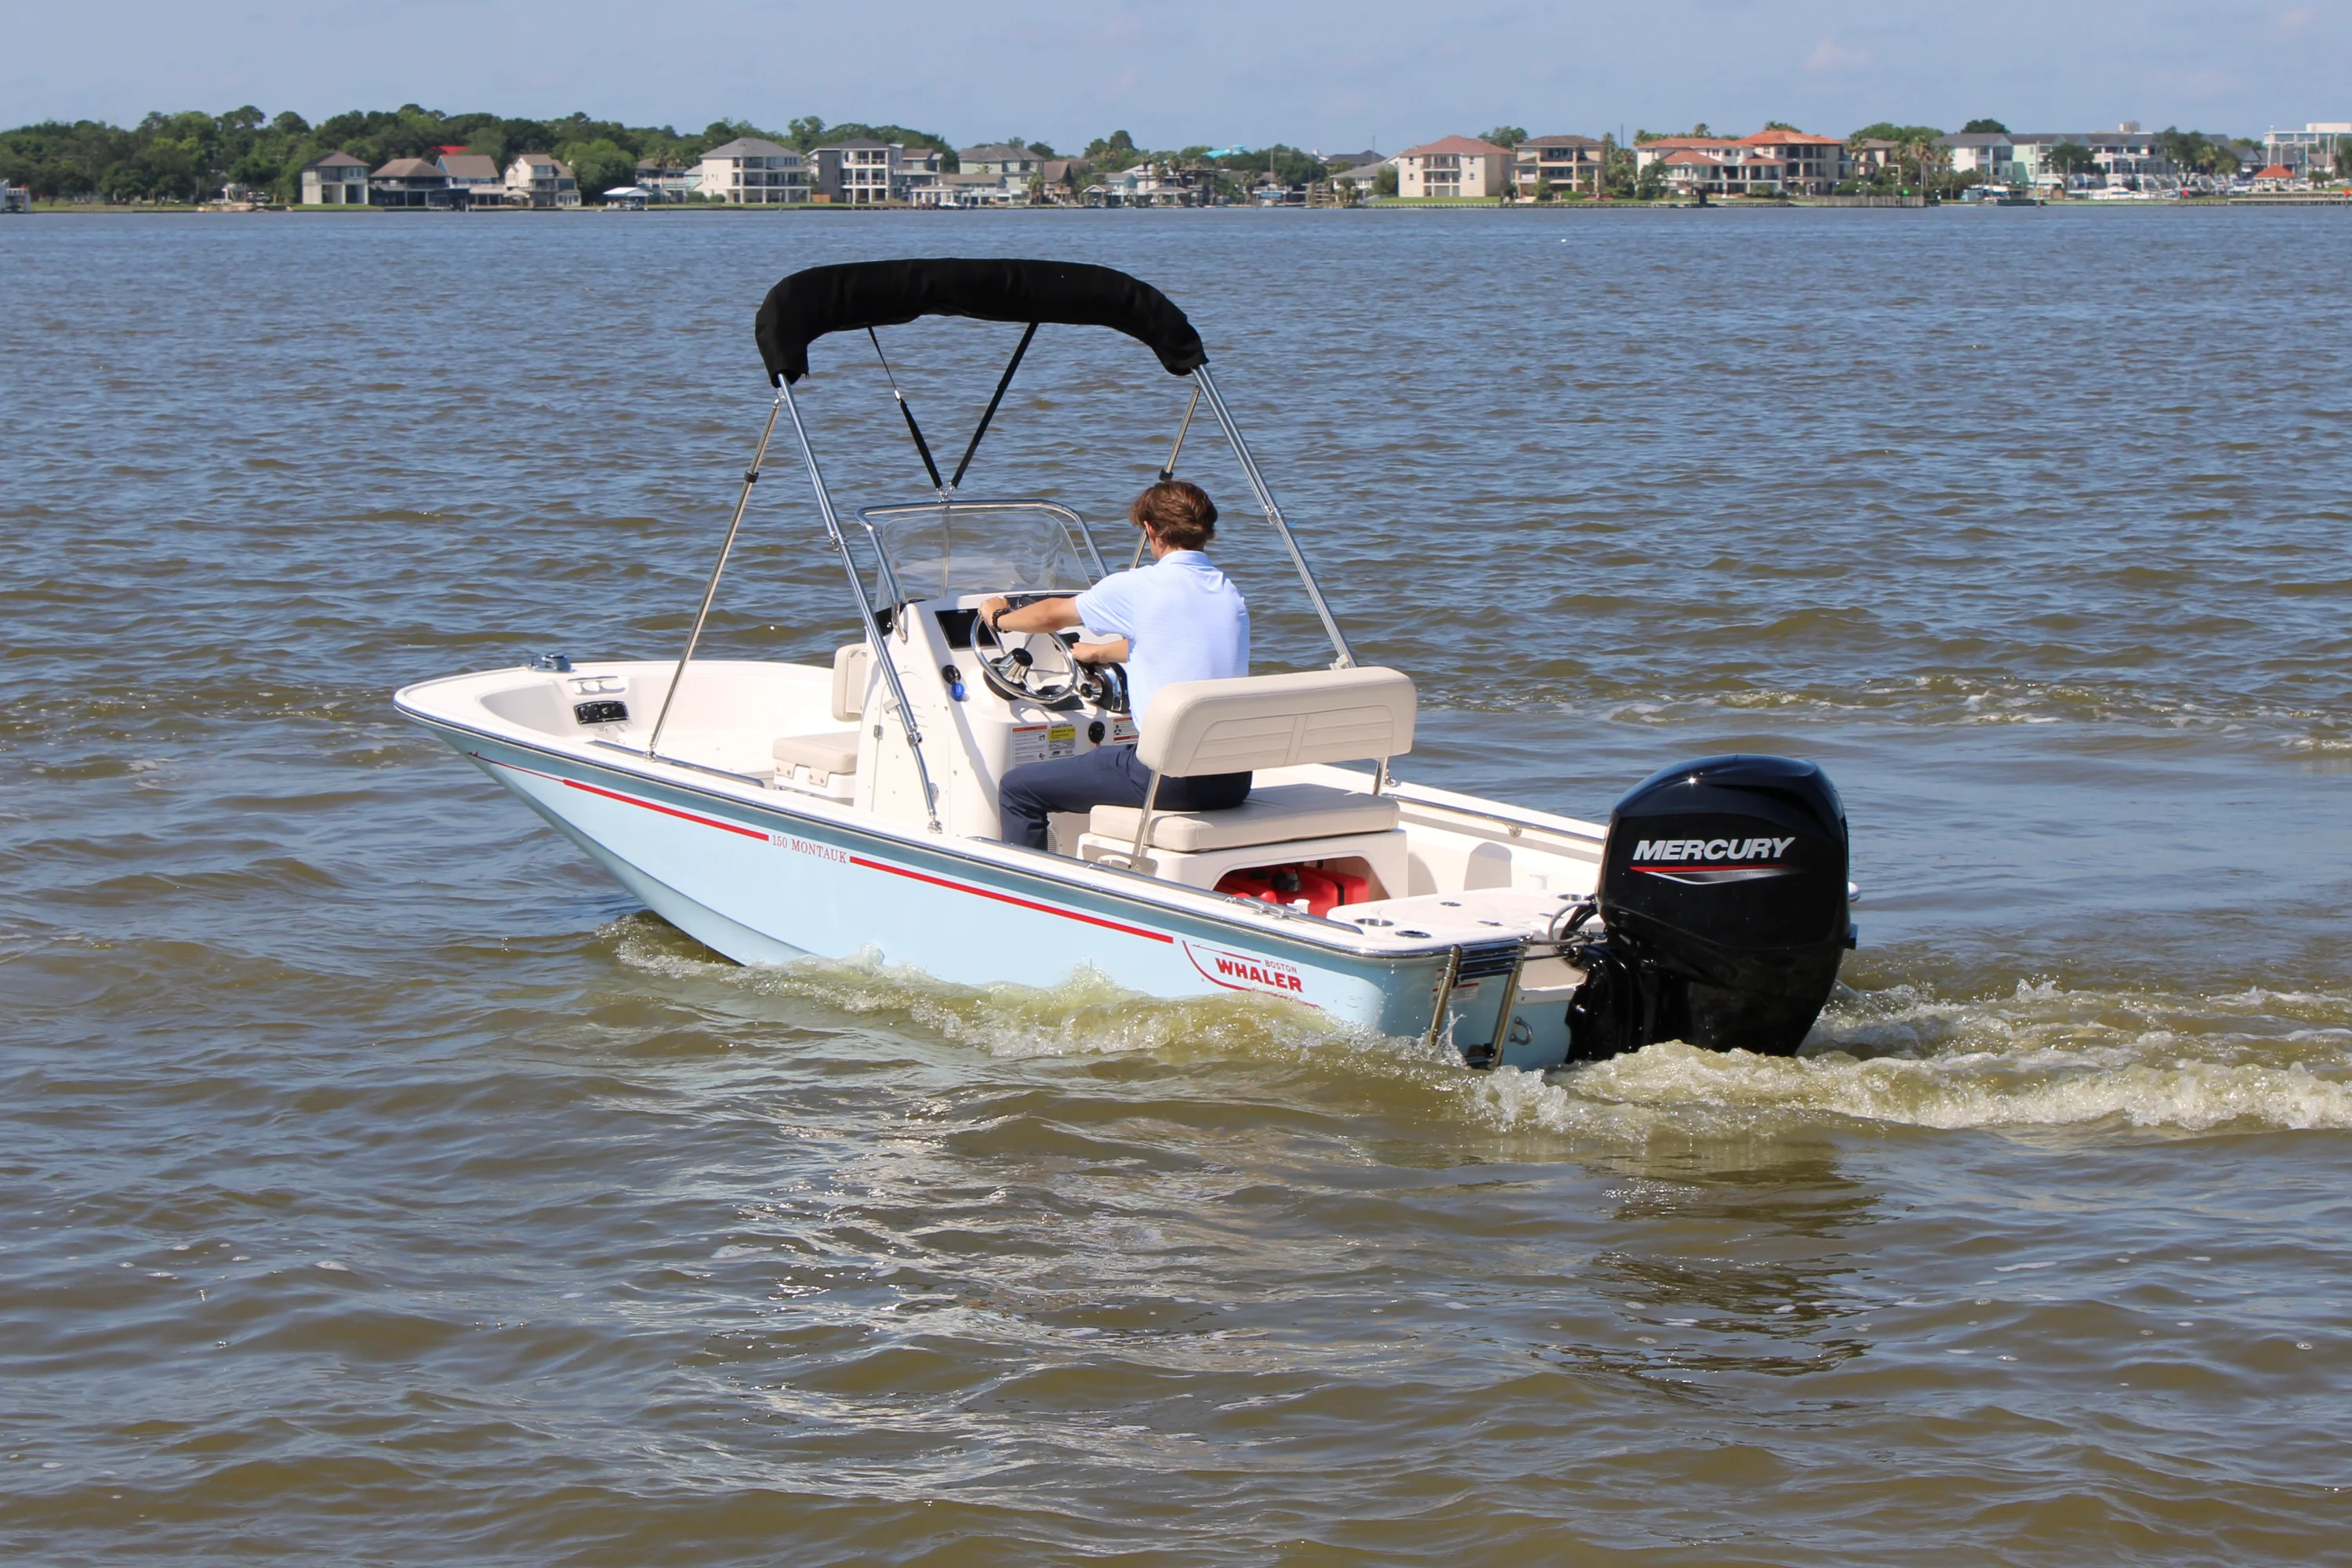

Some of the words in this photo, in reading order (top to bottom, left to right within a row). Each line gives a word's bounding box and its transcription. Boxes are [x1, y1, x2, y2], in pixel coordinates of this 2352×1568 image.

[772, 835, 787, 848] 150
[791, 838, 847, 863] MONTAUK
[1632, 837, 1795, 860] MERCURY
[1215, 957, 1304, 993] WHALER
[1265, 960, 1297, 974] BOSTON
